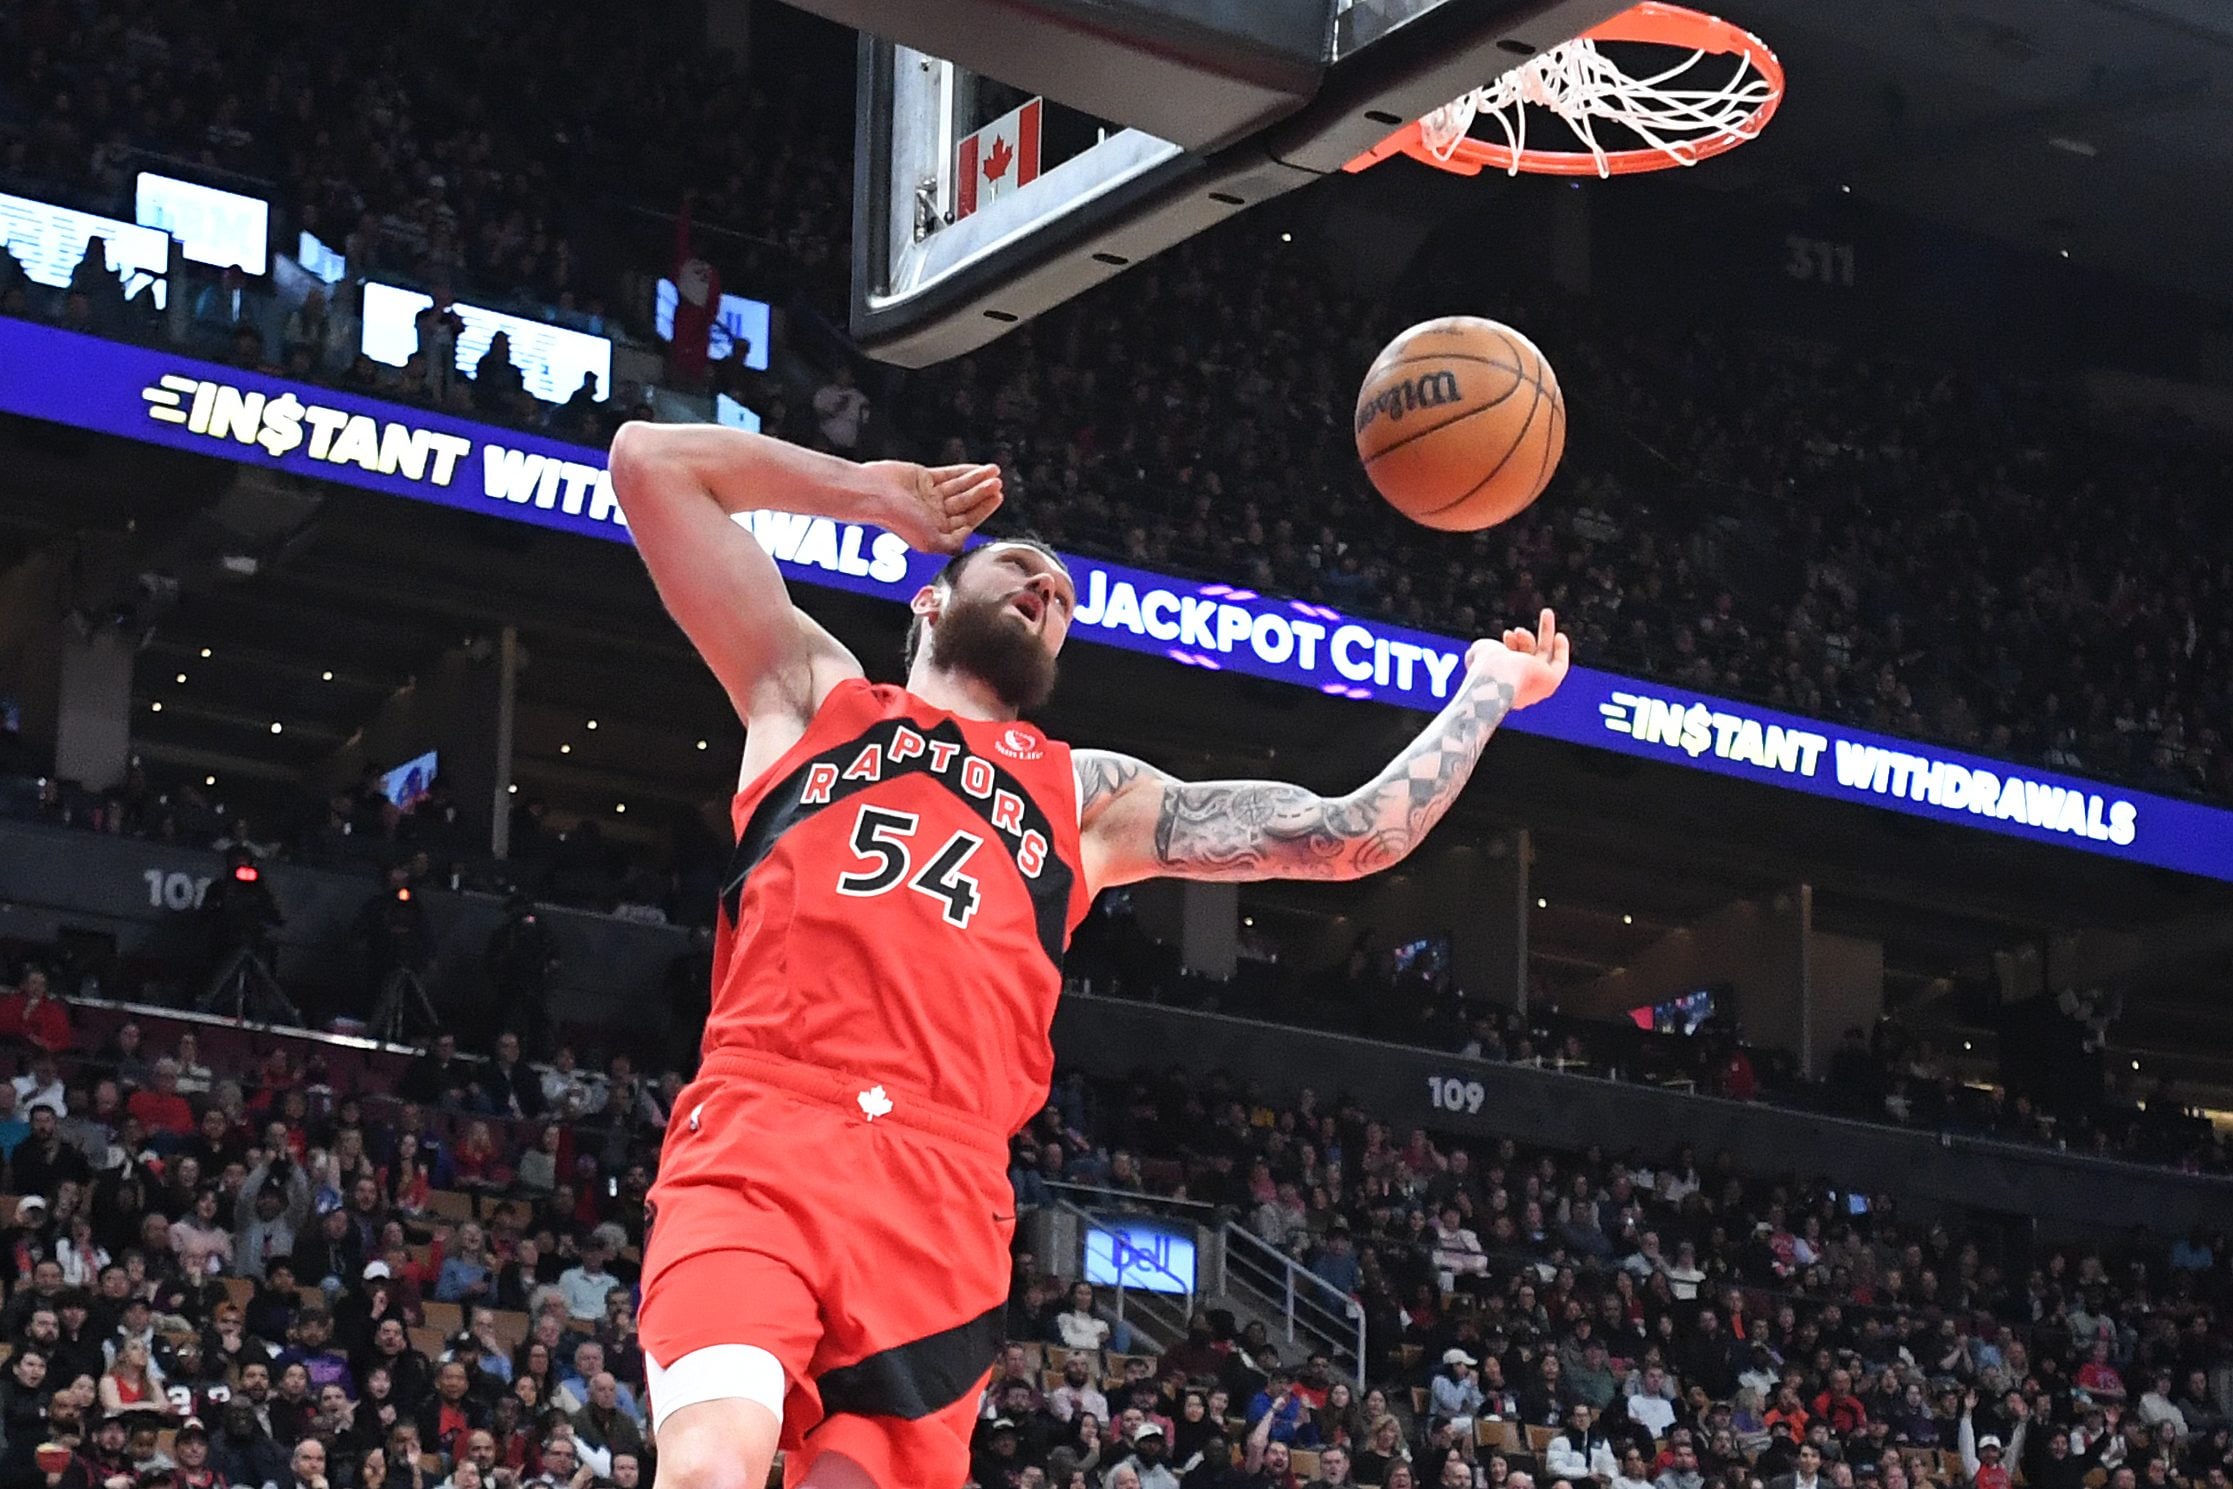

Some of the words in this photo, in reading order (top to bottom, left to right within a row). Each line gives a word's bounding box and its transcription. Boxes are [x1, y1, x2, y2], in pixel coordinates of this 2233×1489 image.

[1357, 370, 1462, 433] Wilso
[1072, 570, 1326, 671] JACKPOT
[1329, 625, 1459, 699] CITY
[1835, 740, 2138, 846] WITHDRAWALS
[799, 725, 1048, 879] RAPTORS
[836, 803, 984, 930] 54
[1428, 1076, 1485, 1115] 109
